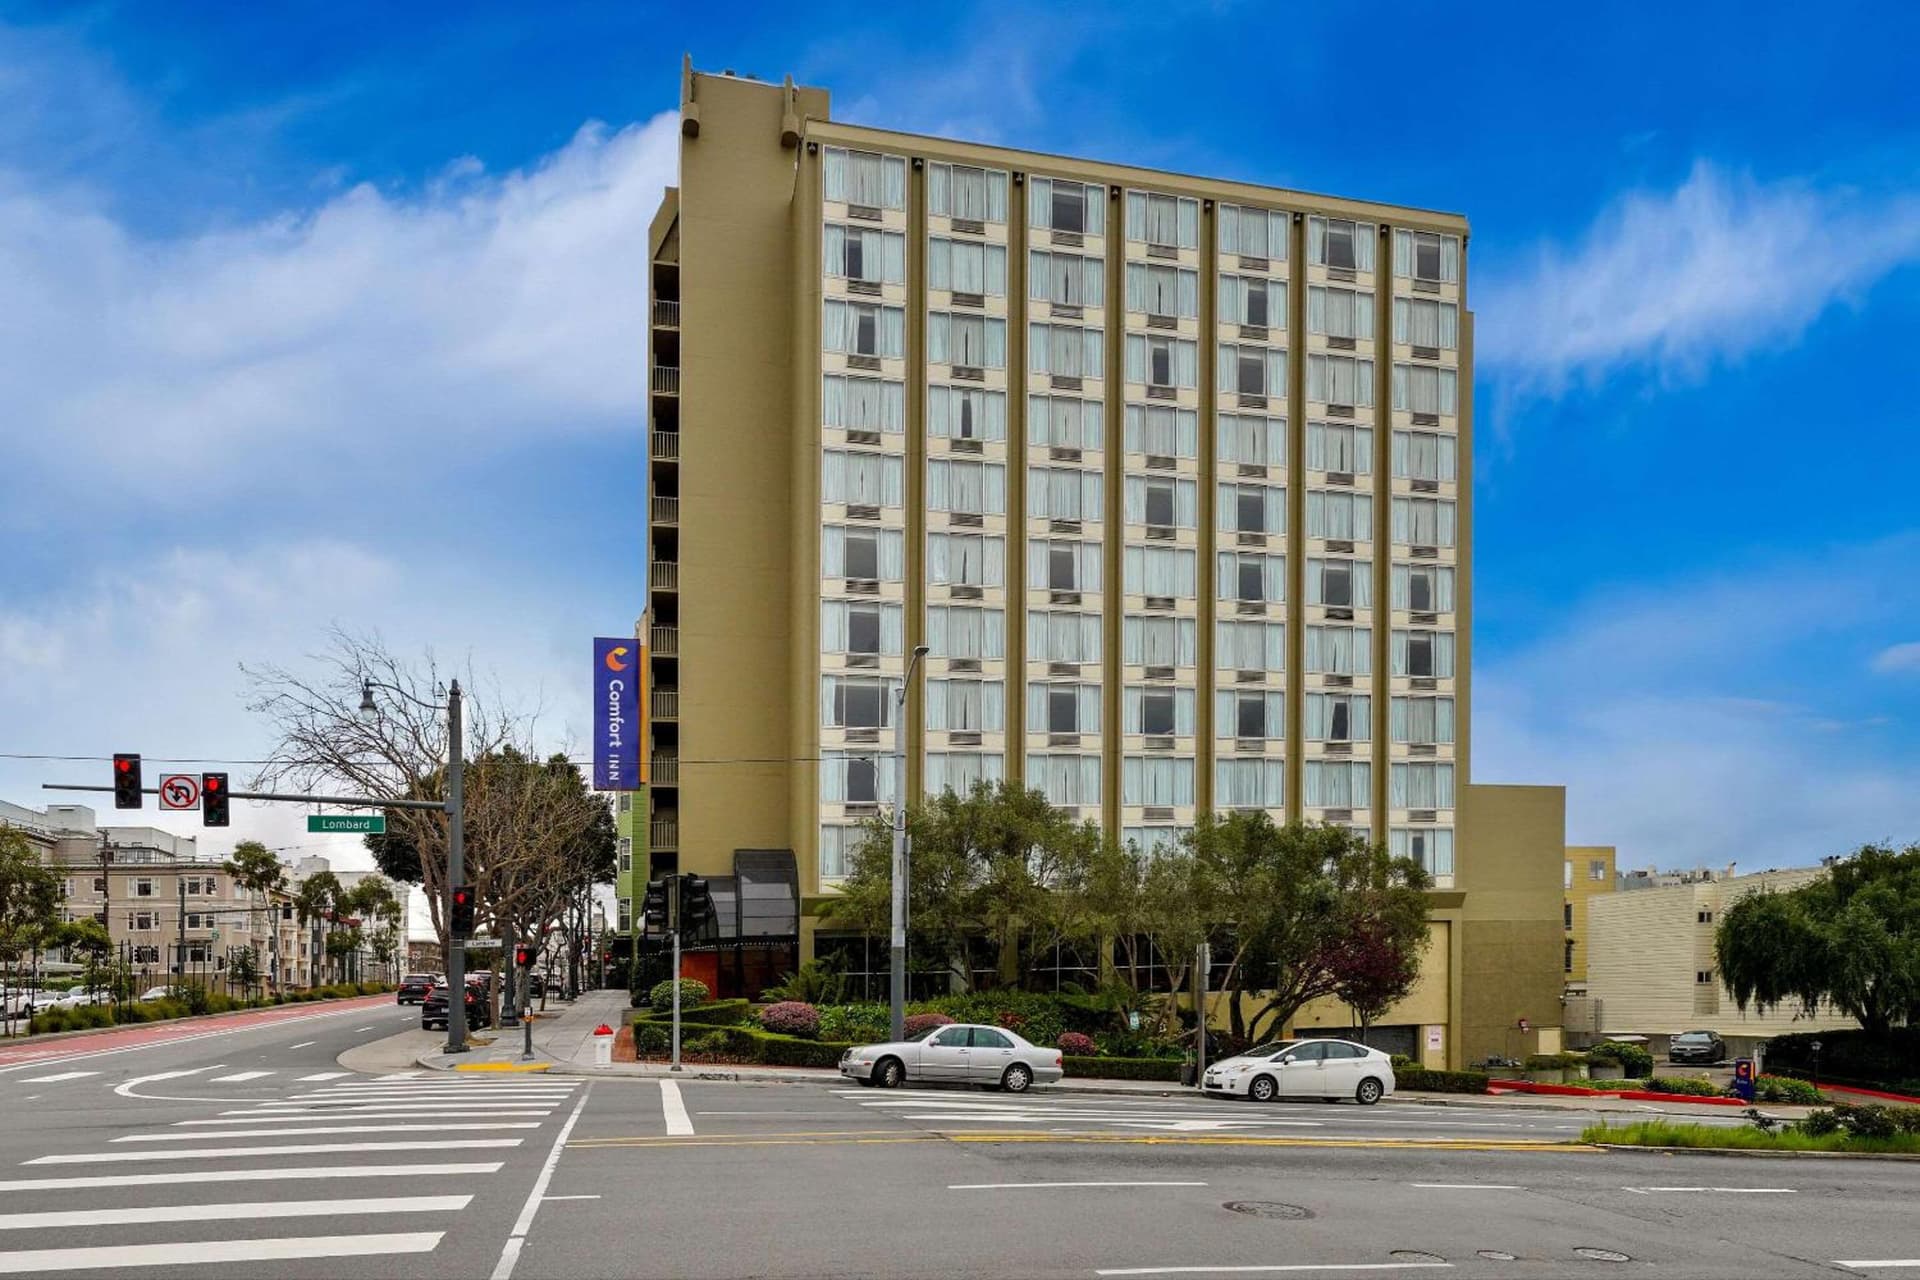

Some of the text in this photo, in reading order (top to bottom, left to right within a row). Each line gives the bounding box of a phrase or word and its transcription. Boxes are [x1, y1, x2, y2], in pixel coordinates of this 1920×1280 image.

[608, 679, 625, 781] Comfort INN
[322, 819, 370, 829] Lombard
